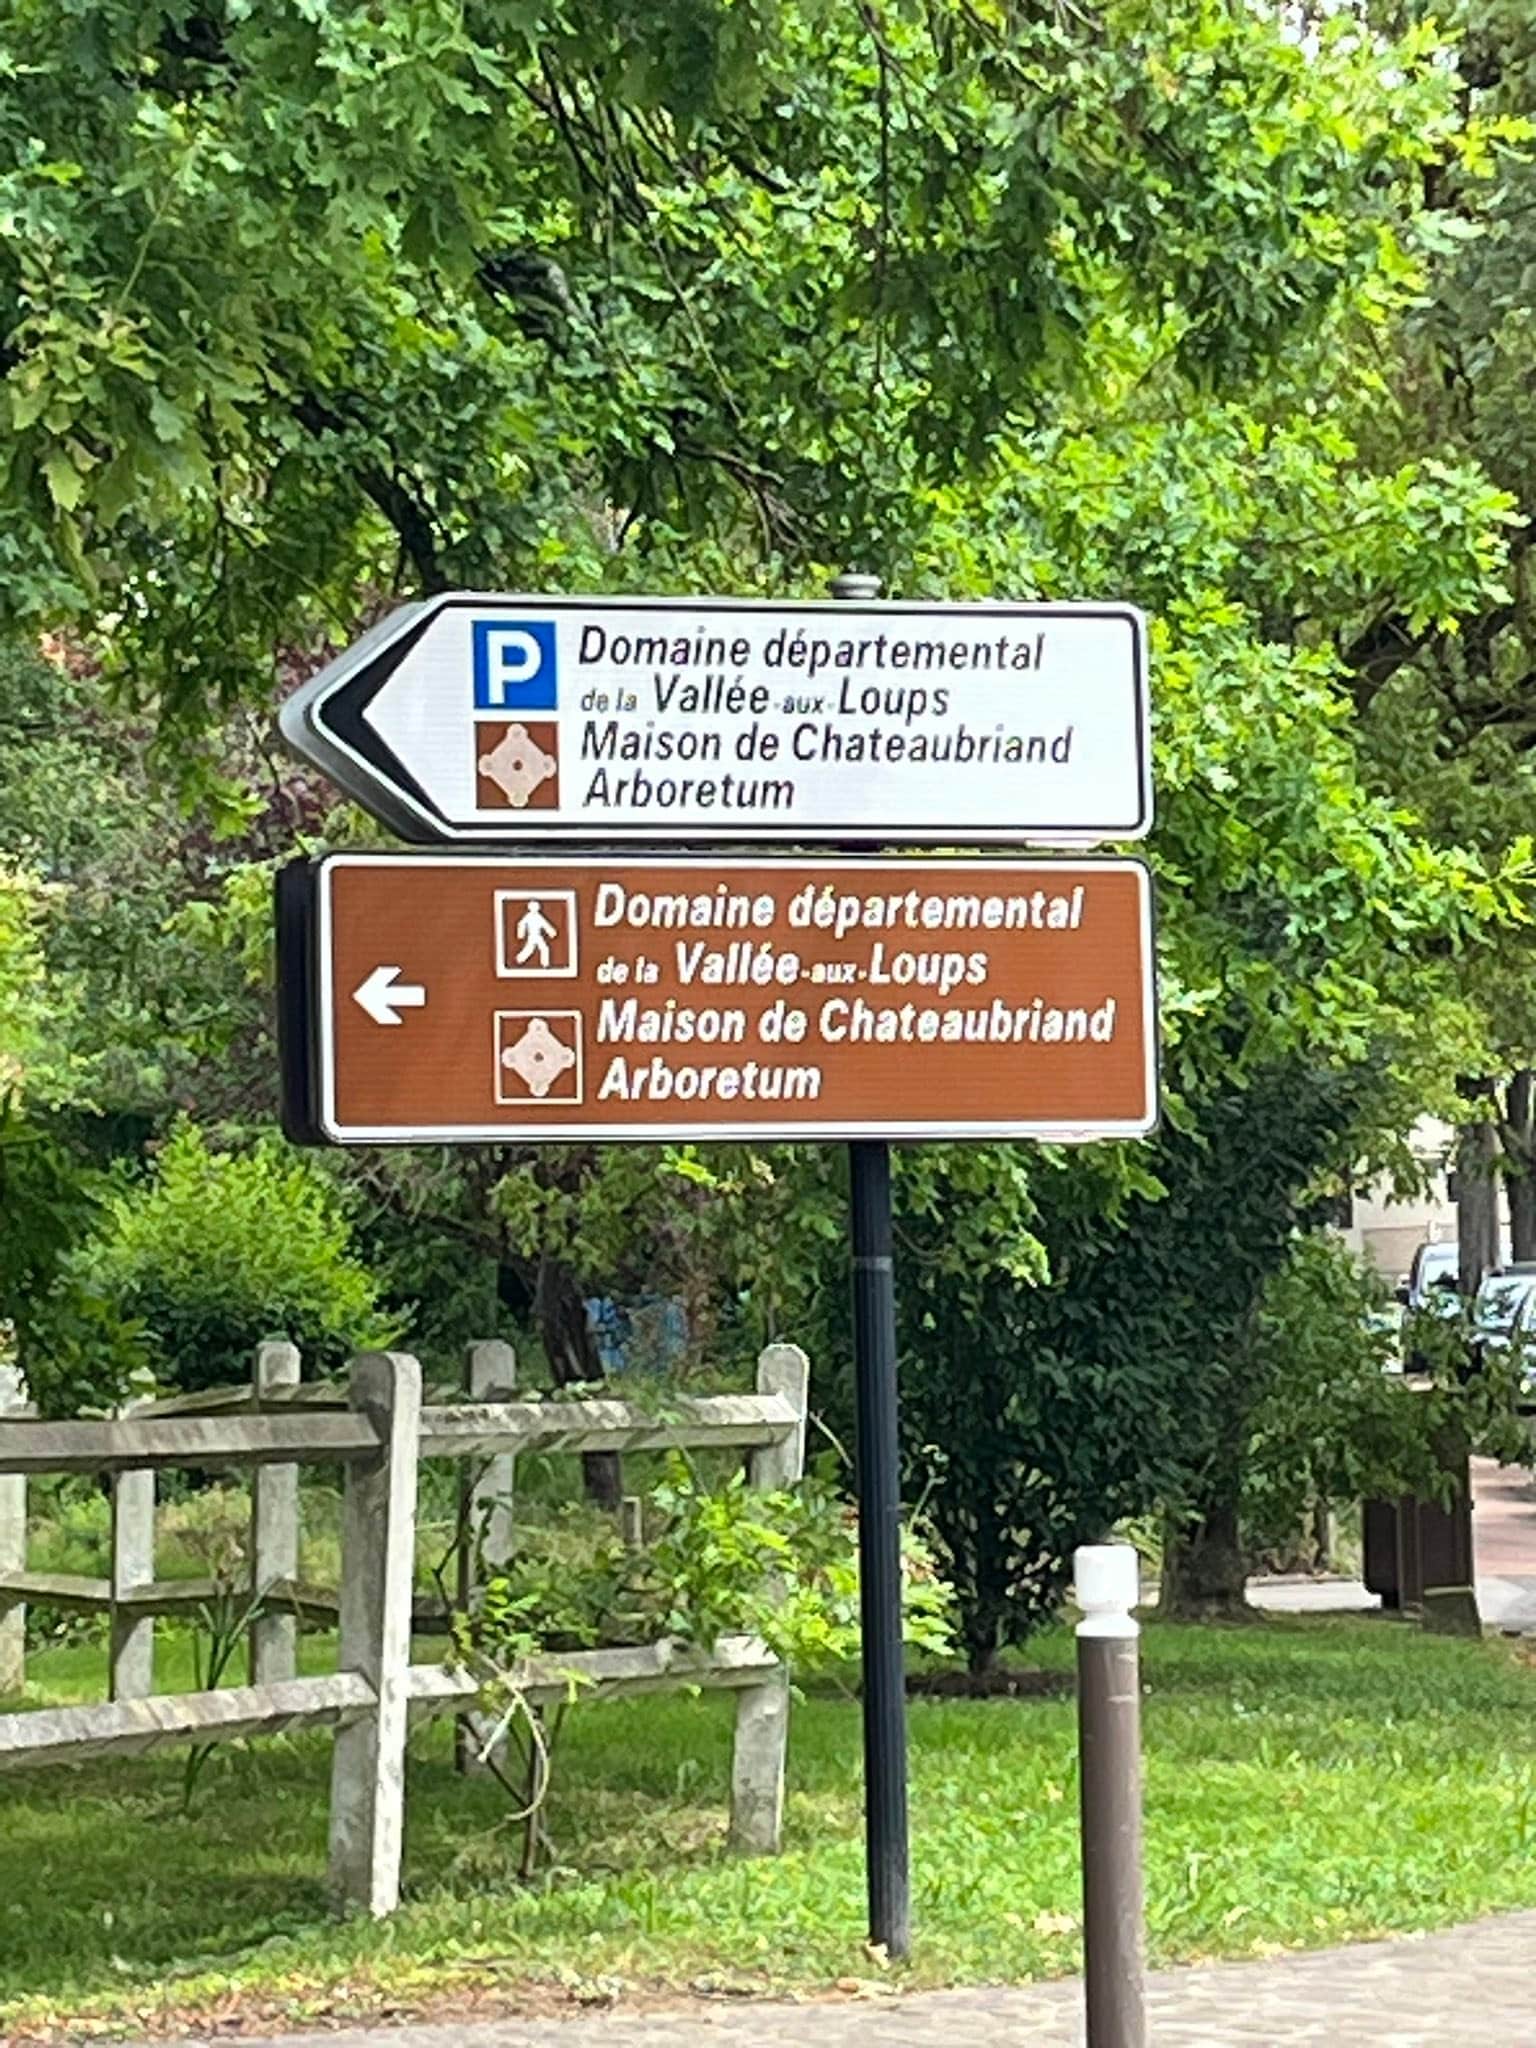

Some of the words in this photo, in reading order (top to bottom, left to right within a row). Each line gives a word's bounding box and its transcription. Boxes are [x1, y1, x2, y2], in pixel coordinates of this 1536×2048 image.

[486, 630, 542, 705] P
[579, 625, 751, 667] Domaine
[763, 628, 1044, 678] départemental
[580, 687, 609, 713] de
[615, 686, 638, 712] la
[580, 720, 720, 763] Maison
[734, 724, 780, 764] de
[791, 724, 1073, 765] Chateaubriand
[582, 768, 795, 810] Arboretum
[594, 882, 776, 929] Domaine
[787, 885, 1085, 940] départemental
[596, 957, 628, 985] de
[634, 957, 659, 985] la
[596, 998, 745, 1044] Maison
[758, 999, 808, 1044] de
[818, 998, 1116, 1044] Chateaubriand
[597, 1055, 823, 1101] Arboretum
